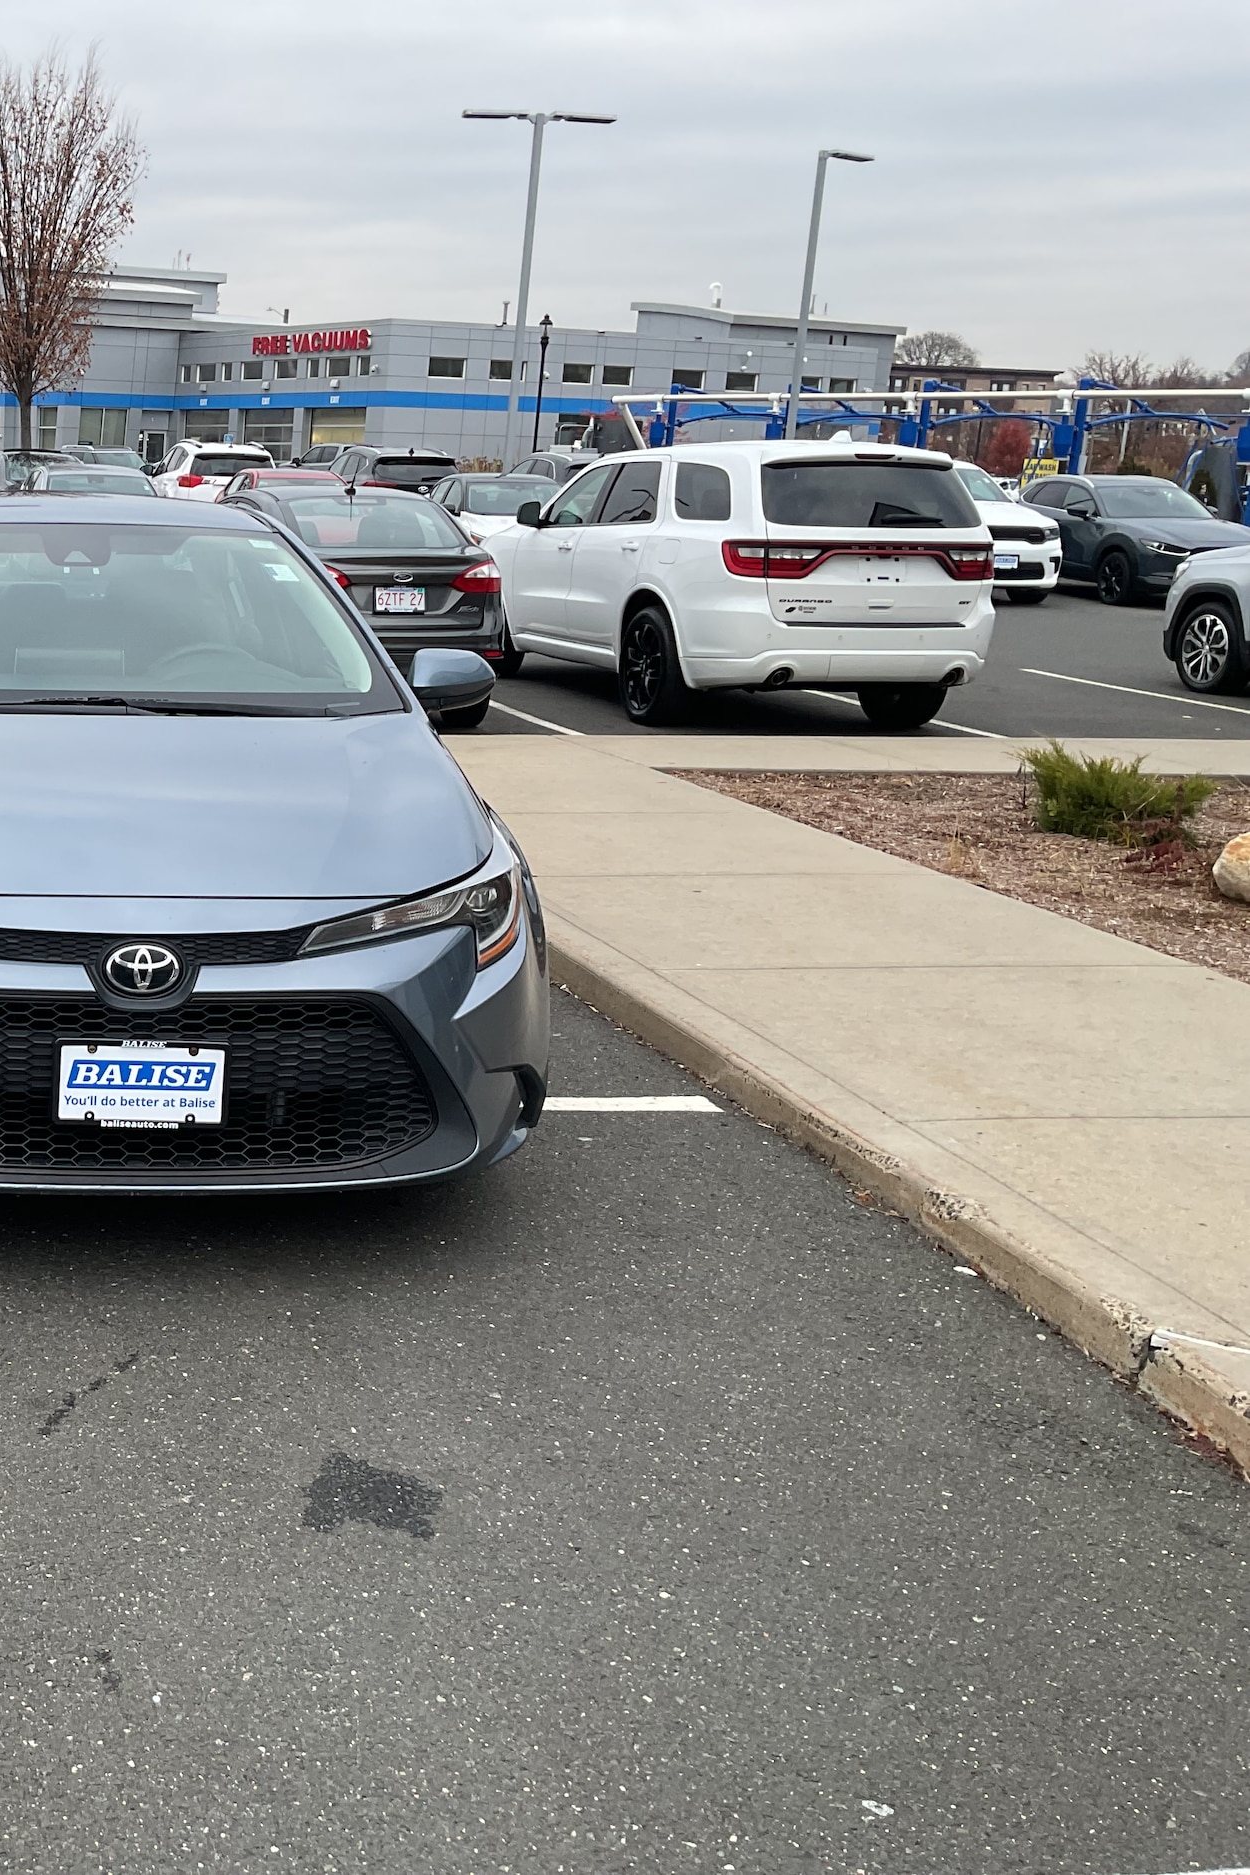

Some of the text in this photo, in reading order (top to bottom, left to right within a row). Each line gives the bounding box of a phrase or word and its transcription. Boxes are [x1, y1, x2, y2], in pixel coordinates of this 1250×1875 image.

[252, 329, 372, 355] FREE VACUUMS
[1039, 463, 1056, 471] WASH
[377, 592, 424, 606] 6ZTF 27
[121, 1040, 167, 1048] BALISE
[72, 1063, 211, 1087] BALISE
[64, 1095, 216, 1108] You'll do better at Balise
[100, 1119, 179, 1129] baliseauto.com
